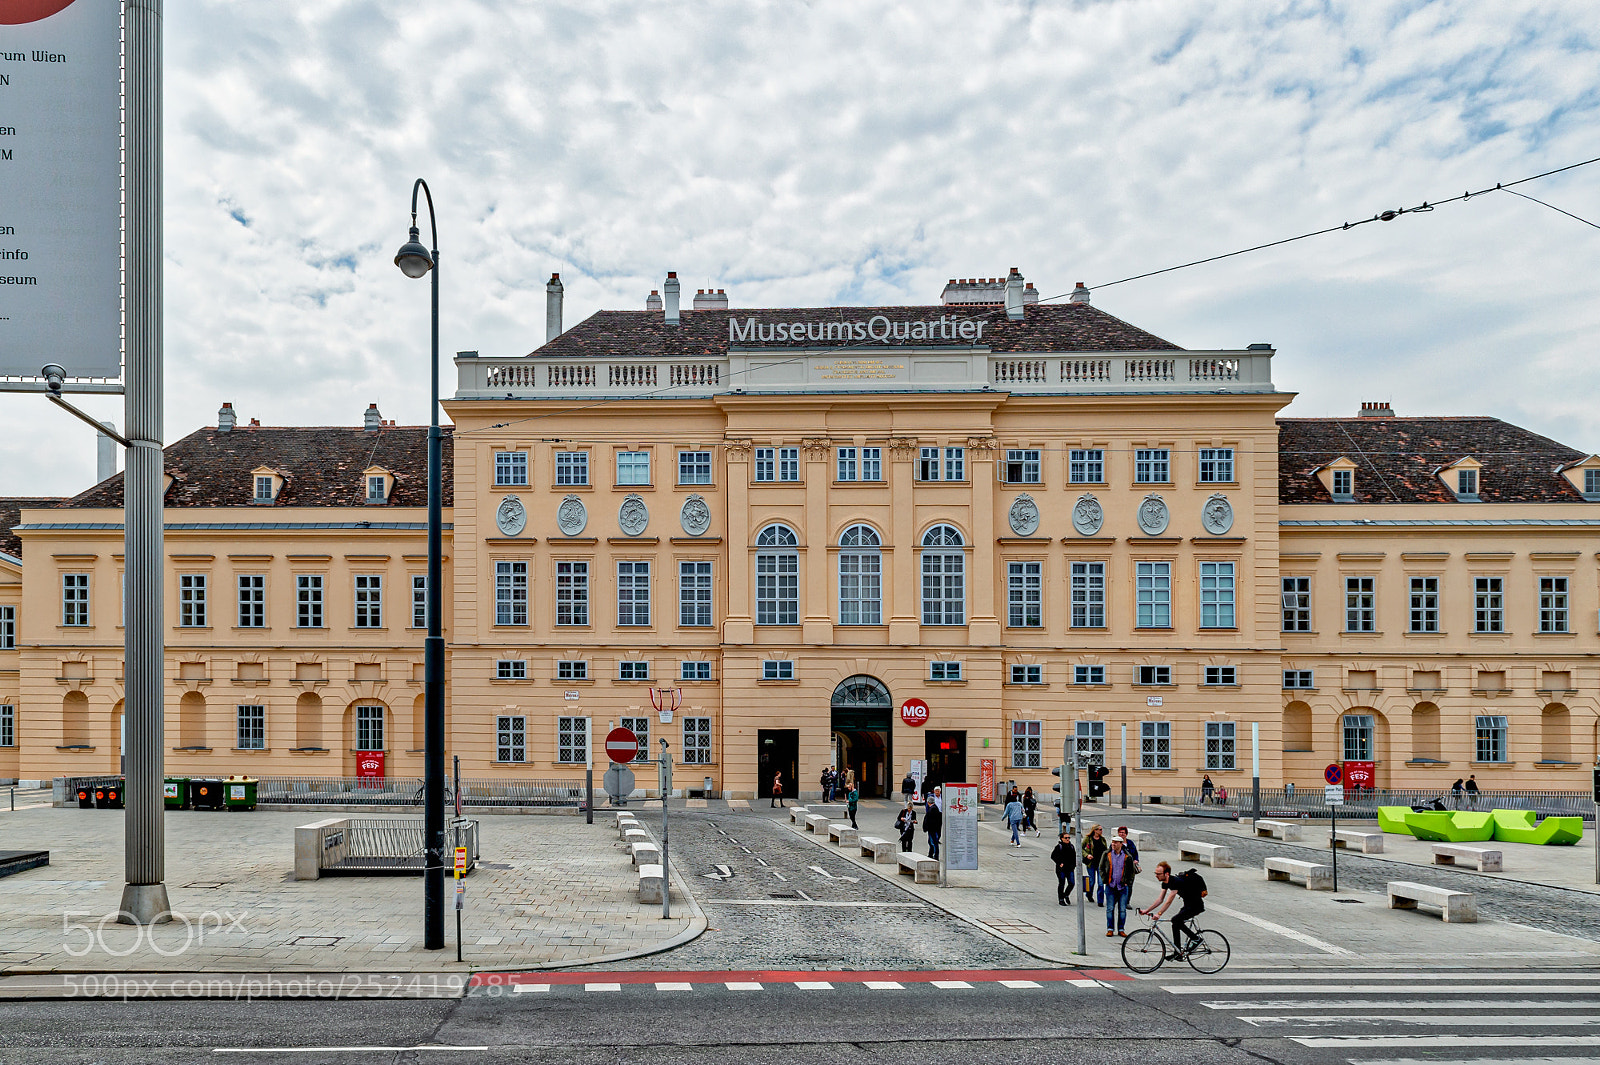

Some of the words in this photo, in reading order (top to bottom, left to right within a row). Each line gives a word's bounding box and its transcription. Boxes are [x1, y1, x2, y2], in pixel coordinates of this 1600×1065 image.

[31, 50, 66, 63] Wien
[0, 248, 29, 260] info
[729, 314, 988, 344] MuseumsQuartier
[903, 705, 927, 717] MQ
